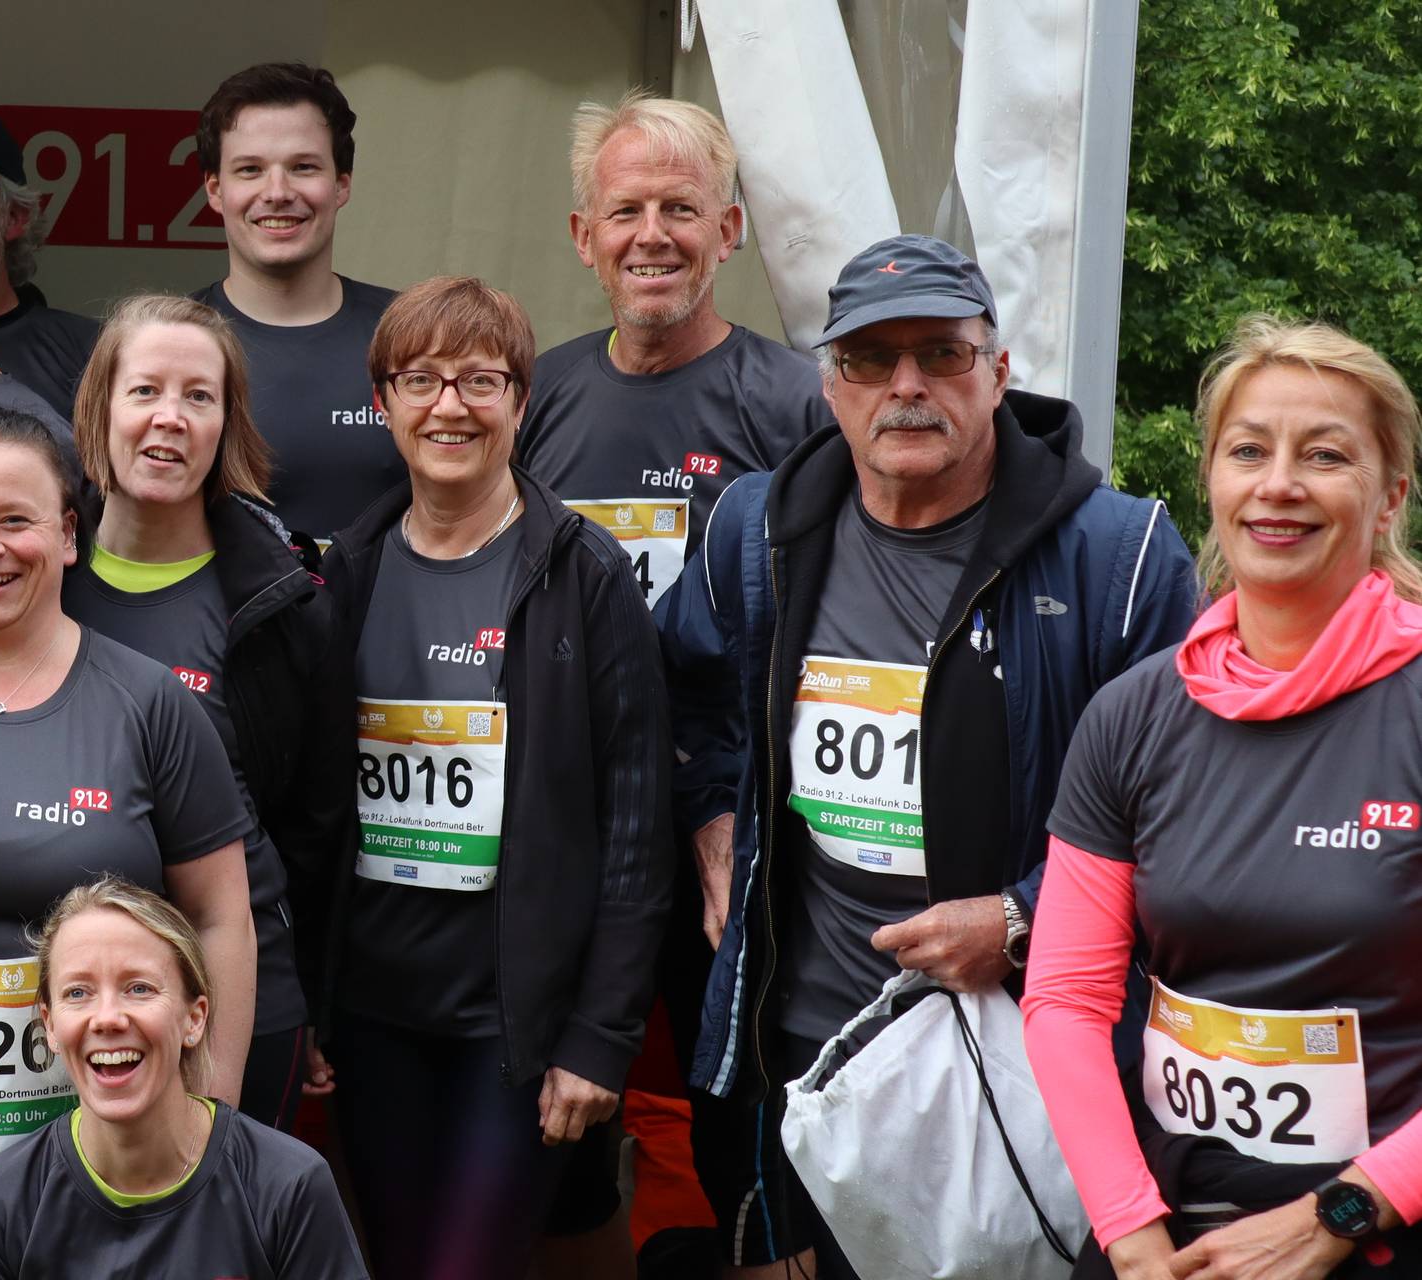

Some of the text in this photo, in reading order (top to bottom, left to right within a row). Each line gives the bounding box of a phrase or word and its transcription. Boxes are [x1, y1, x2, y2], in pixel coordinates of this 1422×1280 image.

[690, 456, 718, 475] 91.2
[642, 466, 694, 490] radio
[480, 629, 505, 648] 91.2
[428, 642, 486, 666] radio
[180, 671, 208, 693] 91.2
[815, 718, 919, 786] 801
[357, 752, 474, 808] 8016
[75, 789, 108, 809] 91.2
[800, 784, 823, 798] Radio
[825, 789, 843, 801] 91.2
[851, 793, 900, 809] Lokalfunk
[15, 801, 86, 826] radio
[371, 814, 384, 822] 91.2
[389, 815, 423, 827] Lokalfunk
[425, 820, 465, 831] Dortmund
[466, 823, 484, 832] Betr
[820, 811, 924, 837] STARTZEIT 18:00
[1366, 803, 1413, 828] 91.2
[364, 833, 412, 849] STARTZEIT
[414, 840, 440, 851] 18:00
[442, 842, 462, 854] Uhr
[1294, 821, 1381, 850] radio
[461, 875, 482, 885] XING
[52, 1084, 74, 1094] Betr
[1163, 1056, 1316, 1146] 8032
[25, 1109, 48, 1121] Uhr
